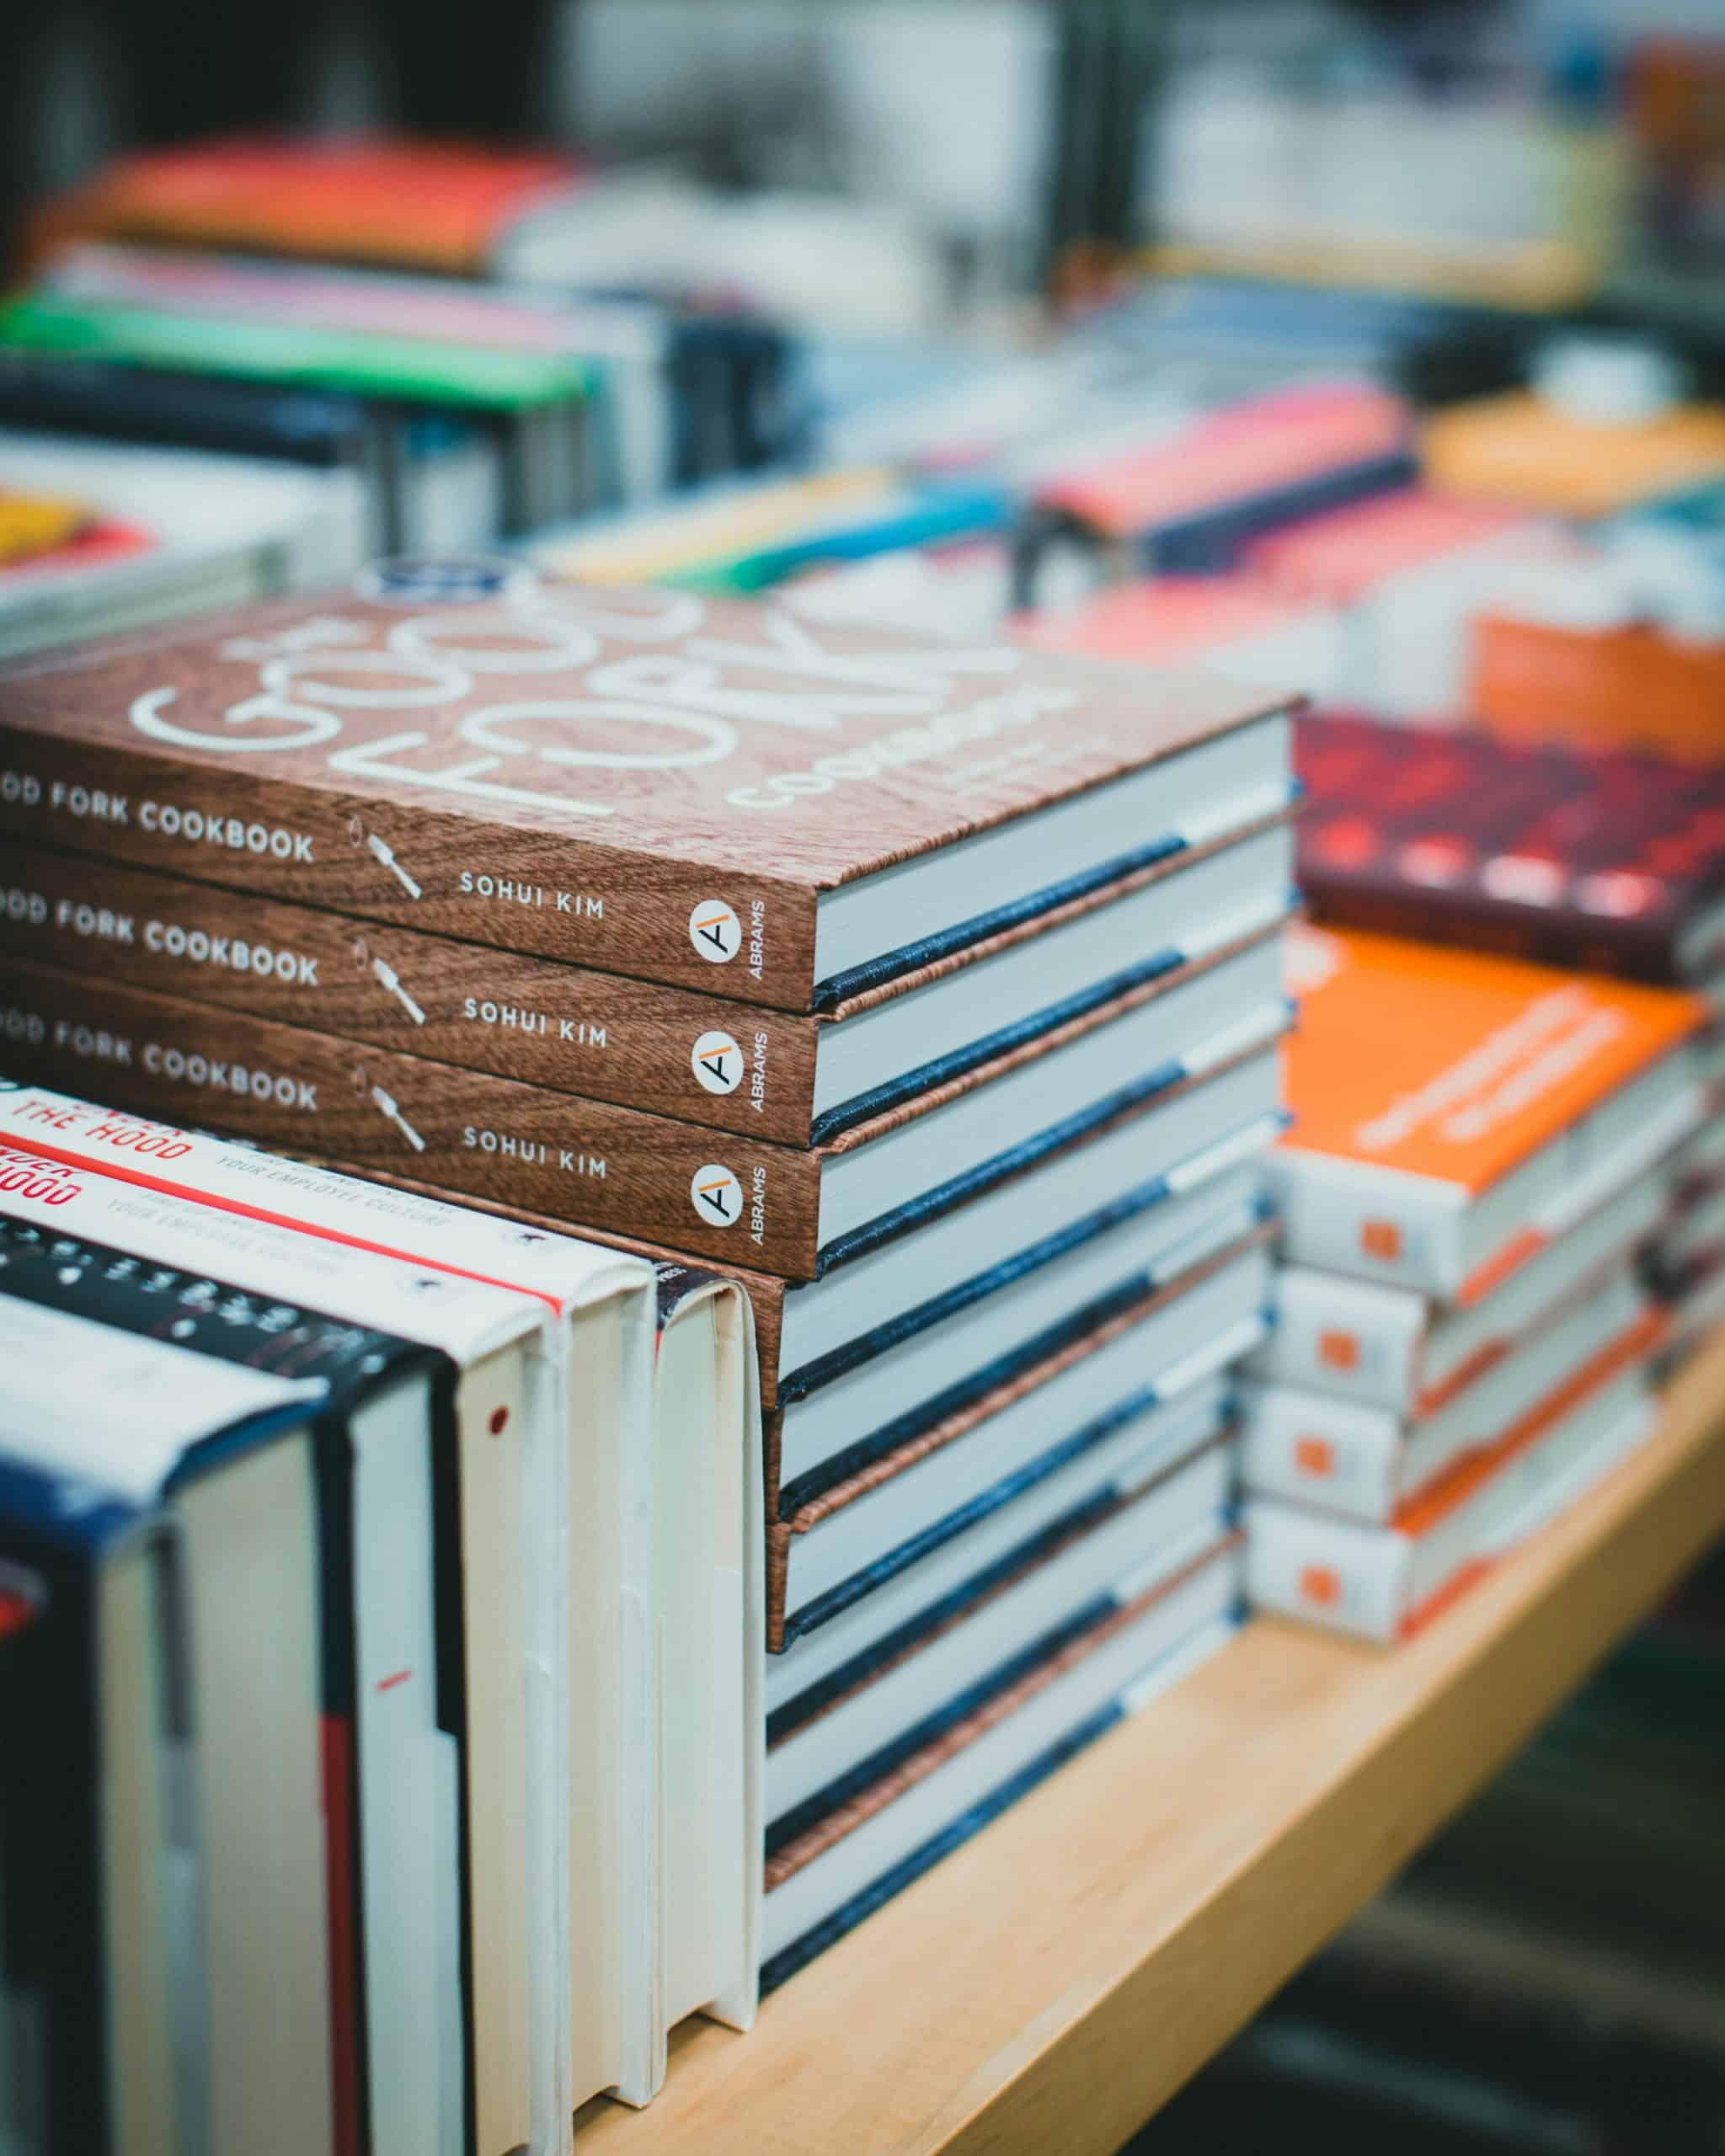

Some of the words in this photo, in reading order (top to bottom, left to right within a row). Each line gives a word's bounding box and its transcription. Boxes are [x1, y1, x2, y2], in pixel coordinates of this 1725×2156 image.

[327, 606, 1023, 815] FORK
[51, 781, 129, 825] FORK
[138, 801, 315, 863] COOKBOOK
[460, 872, 543, 906] SOHUI
[557, 890, 604, 919] KIM
[0, 888, 48, 924] OD
[58, 899, 135, 944] FORK
[144, 921, 319, 987] COOKBOOK
[745, 899, 766, 981] ABRAMS
[0, 1009, 45, 1045] OD
[55, 1021, 132, 1065] FORK
[143, 1044, 318, 1111] COOKBOOK
[463, 998, 547, 1035] SOHUI
[559, 1020, 607, 1049] KIM
[750, 1032, 769, 1113] ABRAMS
[13, 1099, 88, 1130] THE
[85, 1123, 193, 1160] HOOD
[217, 1155, 263, 1176] YOUR
[463, 1126, 547, 1165] SOHUI
[559, 1150, 607, 1179] KIM
[750, 1166, 766, 1247] ABRAMS
